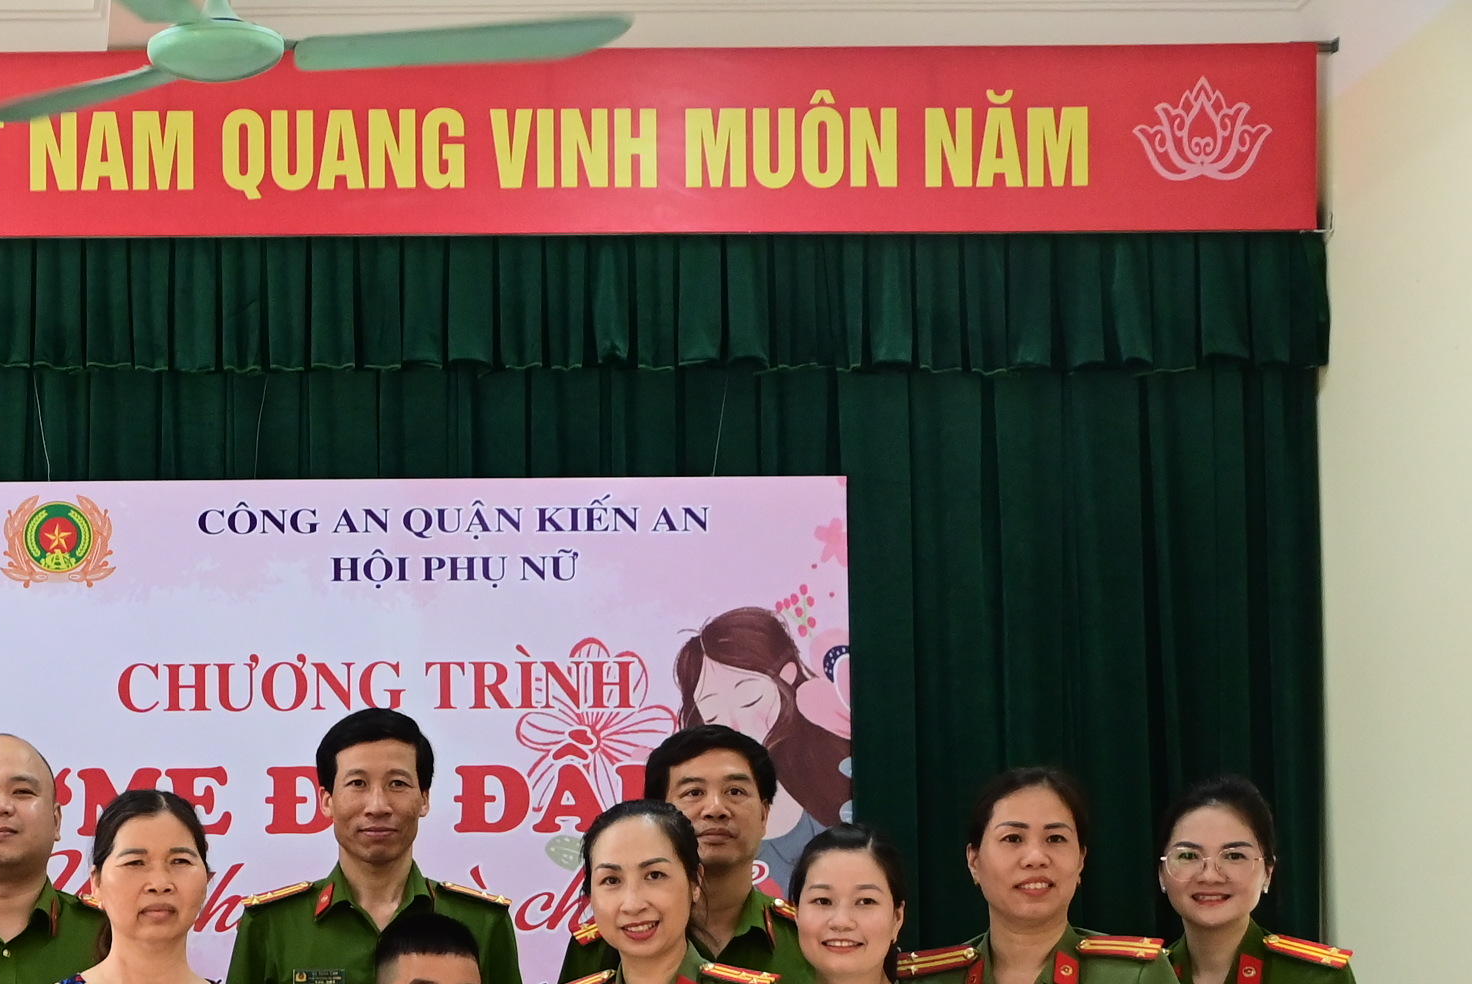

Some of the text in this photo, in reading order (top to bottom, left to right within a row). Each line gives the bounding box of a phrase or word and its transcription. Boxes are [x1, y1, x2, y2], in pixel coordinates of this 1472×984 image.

[29, 110, 195, 192] NAM
[221, 105, 467, 199] QUANG
[490, 105, 657, 190] VINH
[684, 88, 900, 189] MUÔN
[924, 89, 1090, 188] NĂM
[197, 494, 710, 540] CÔNG AN QUẬN KIẾN AN
[330, 549, 580, 589] HỘI PHỤ NỮ
[117, 643, 640, 714] CHƯƠNG TRÌNH
